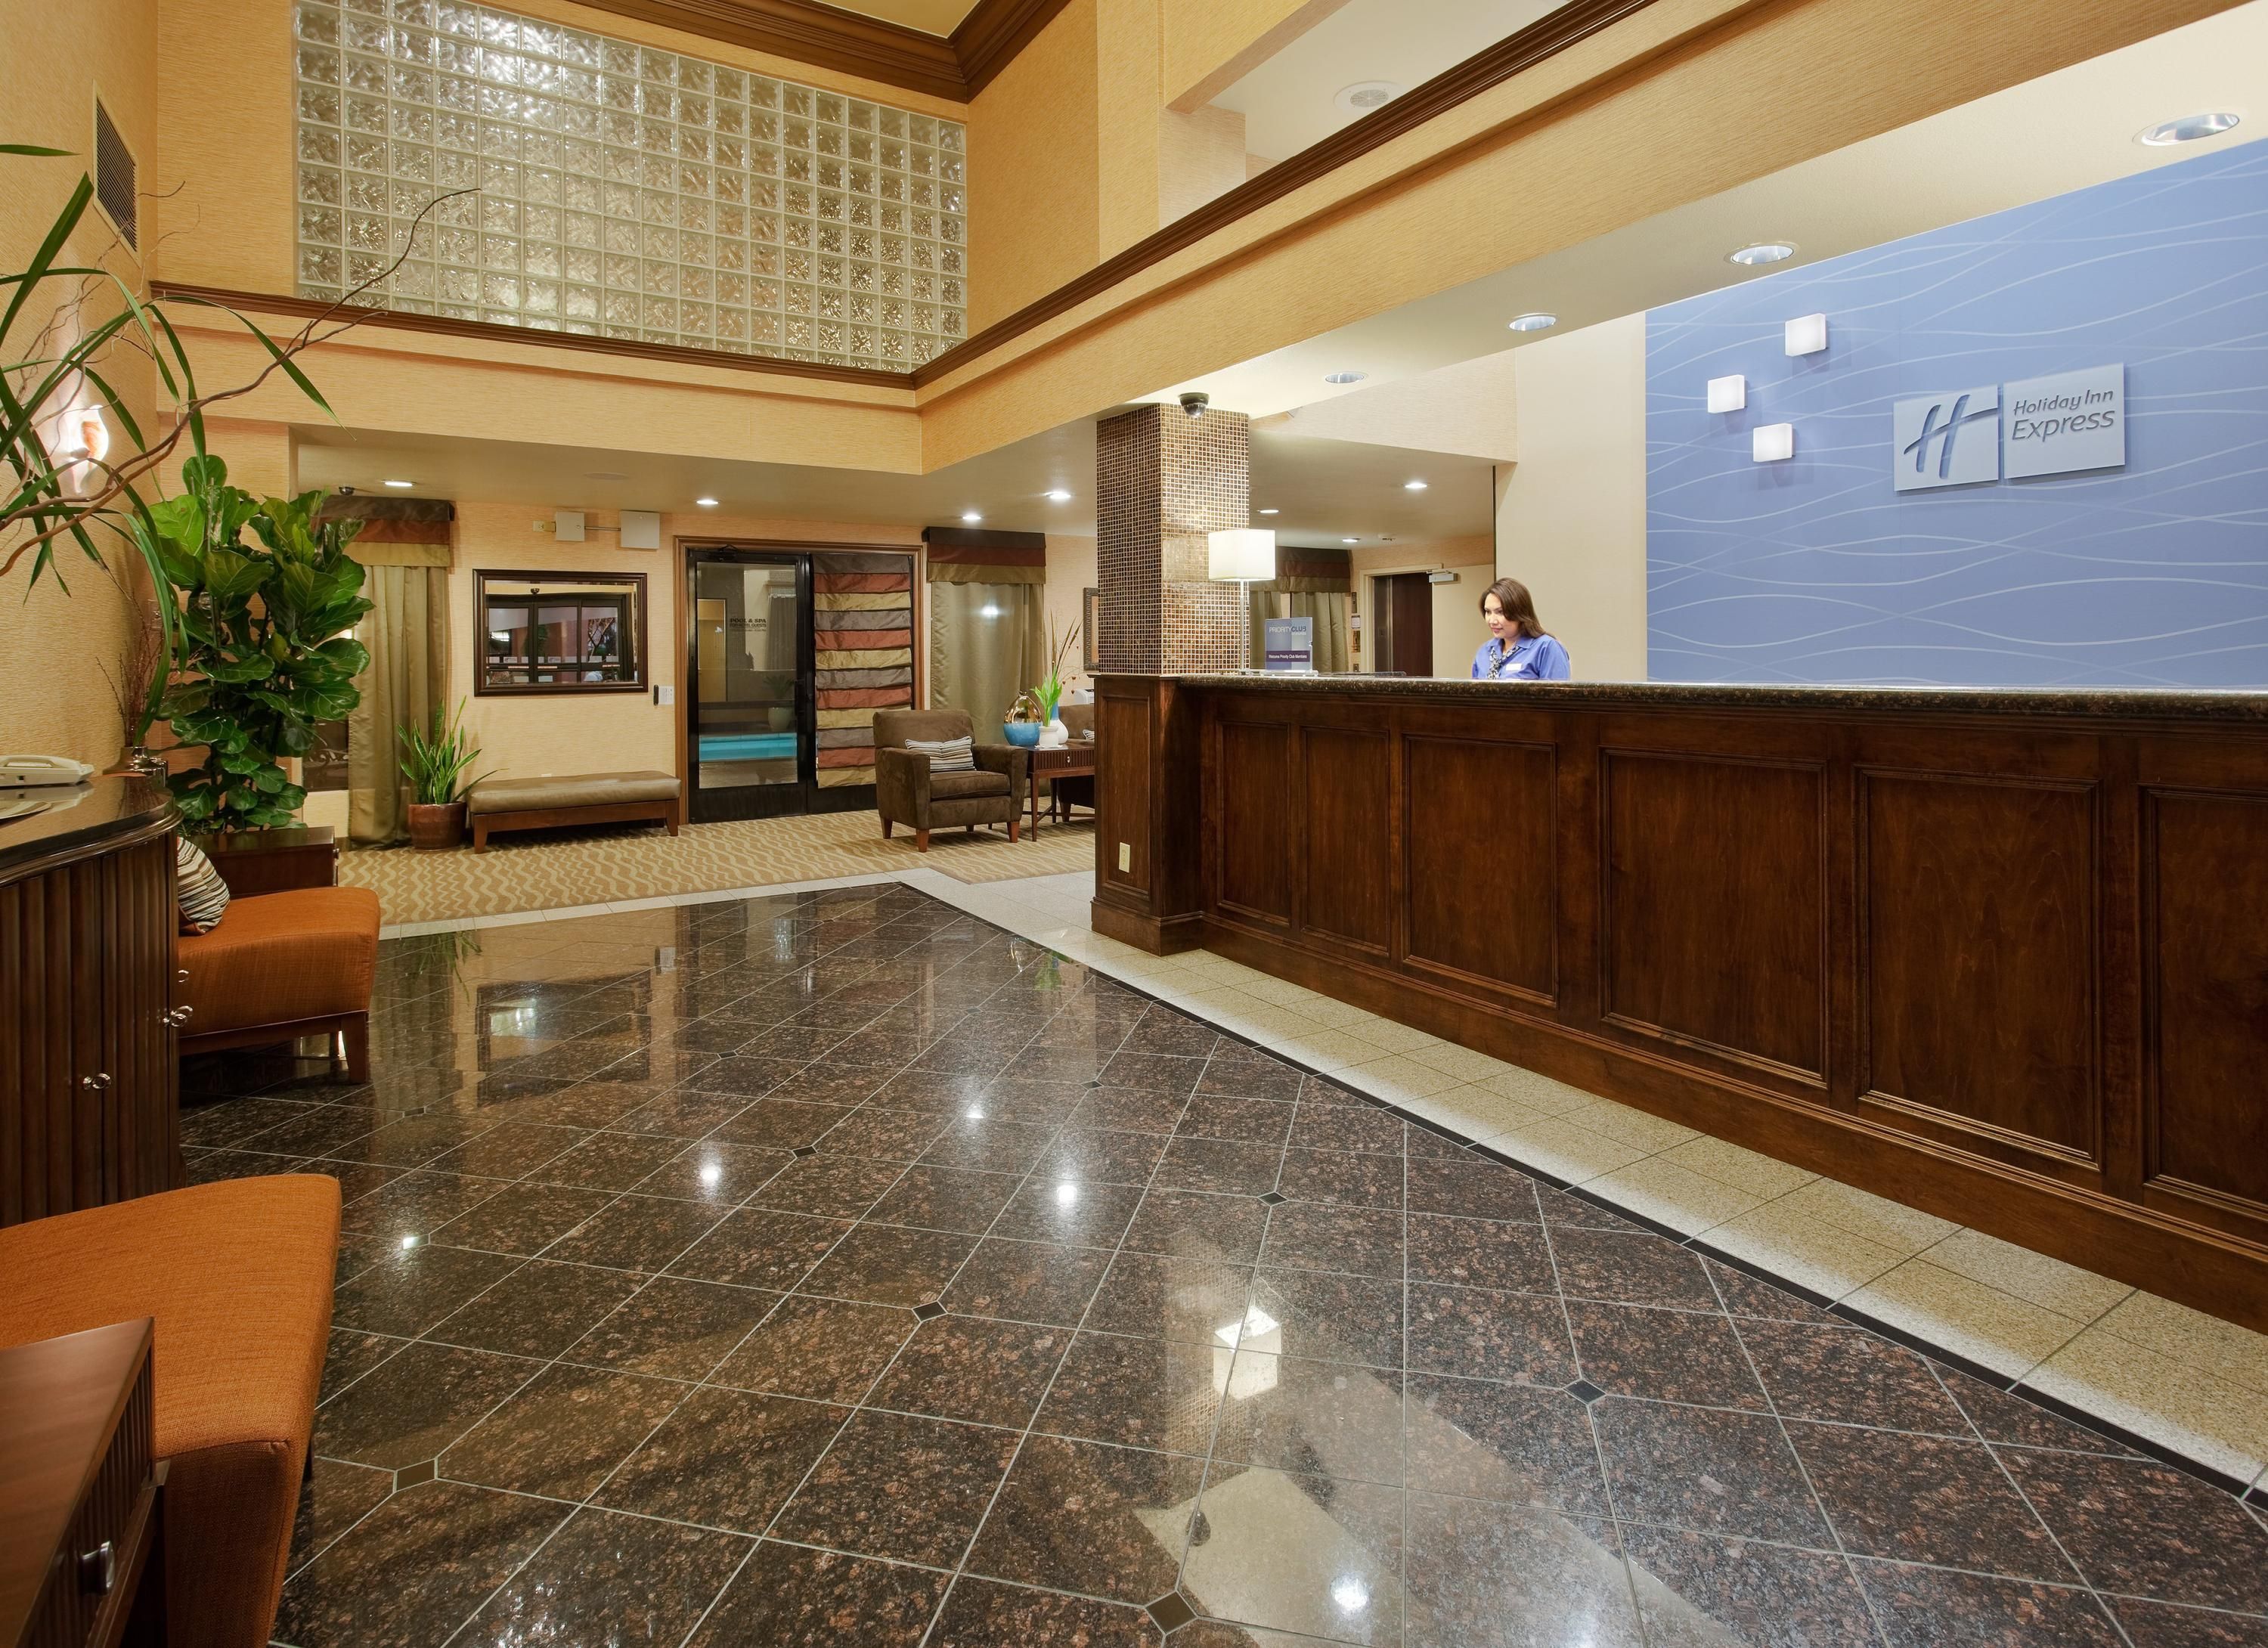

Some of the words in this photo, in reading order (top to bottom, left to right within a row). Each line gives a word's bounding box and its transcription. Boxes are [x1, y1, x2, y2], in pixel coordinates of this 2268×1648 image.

[2014, 395, 2081, 416] Holiday
[2084, 389, 2114, 404] Inn
[2012, 410, 2115, 442] Express
